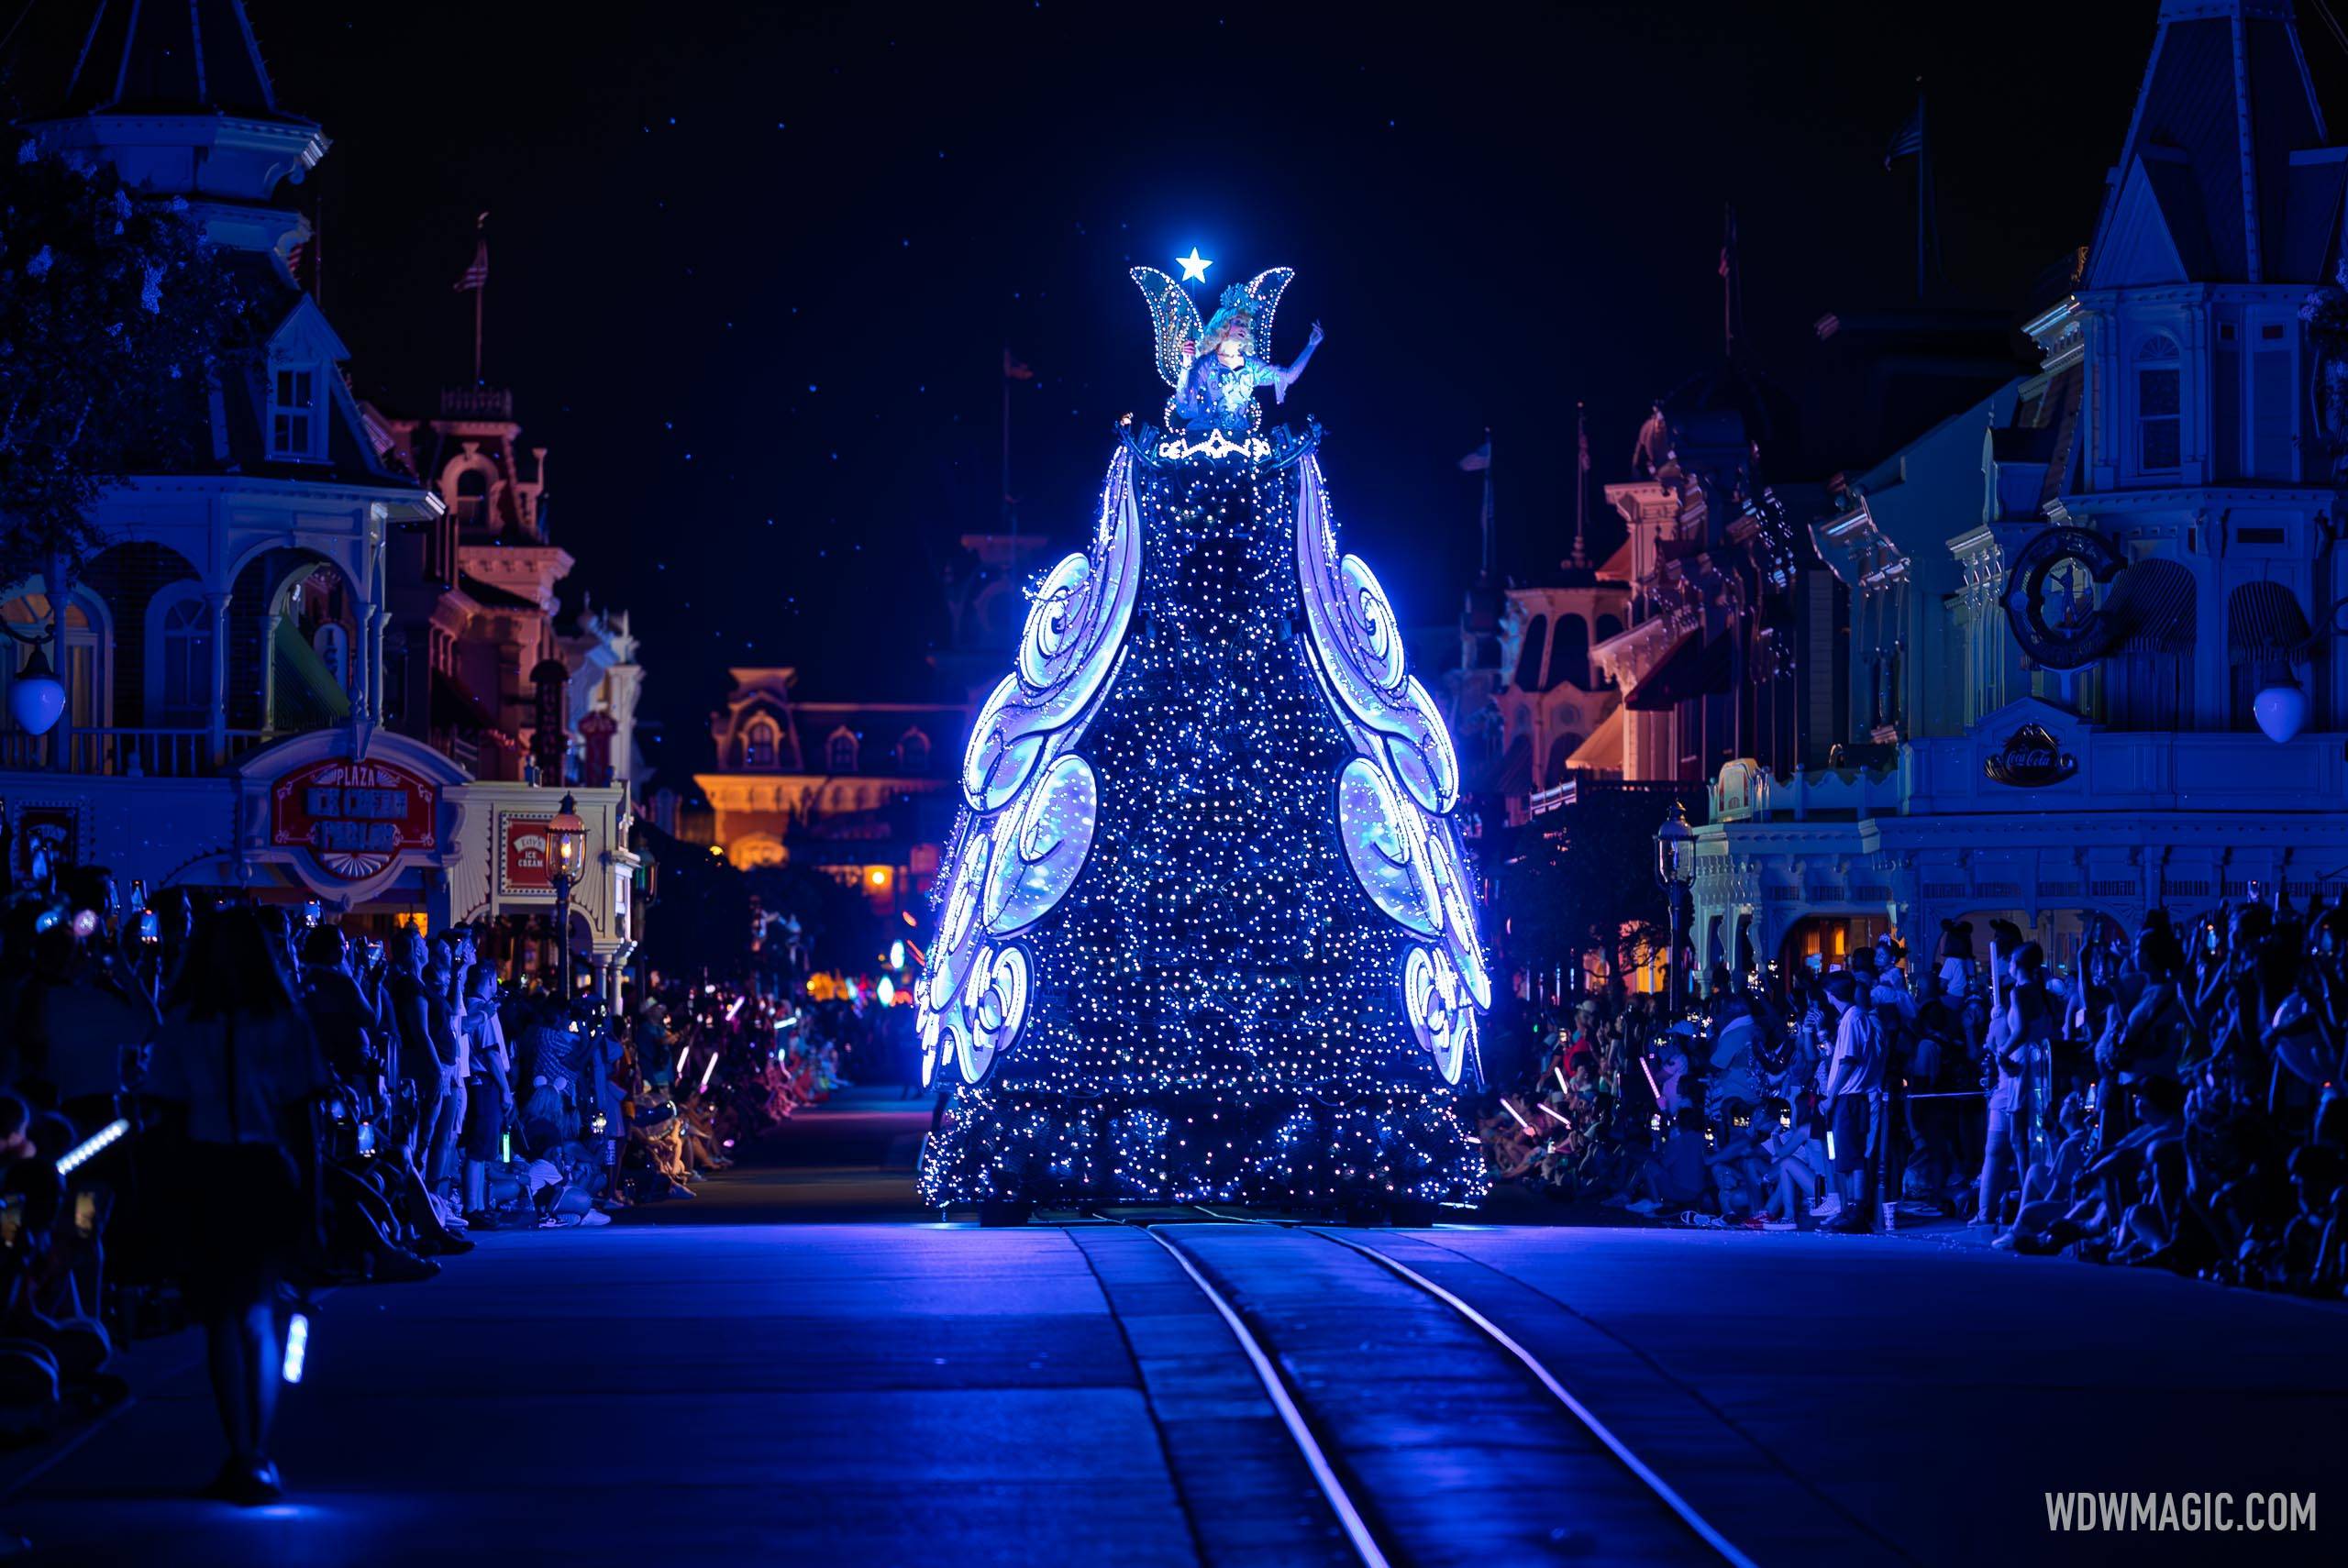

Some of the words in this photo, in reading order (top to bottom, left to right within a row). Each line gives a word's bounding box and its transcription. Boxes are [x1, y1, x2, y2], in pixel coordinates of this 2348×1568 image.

[336, 765, 376, 788] PLAZA
[525, 850, 537, 859] ICE
[517, 858, 544, 868] CREAM
